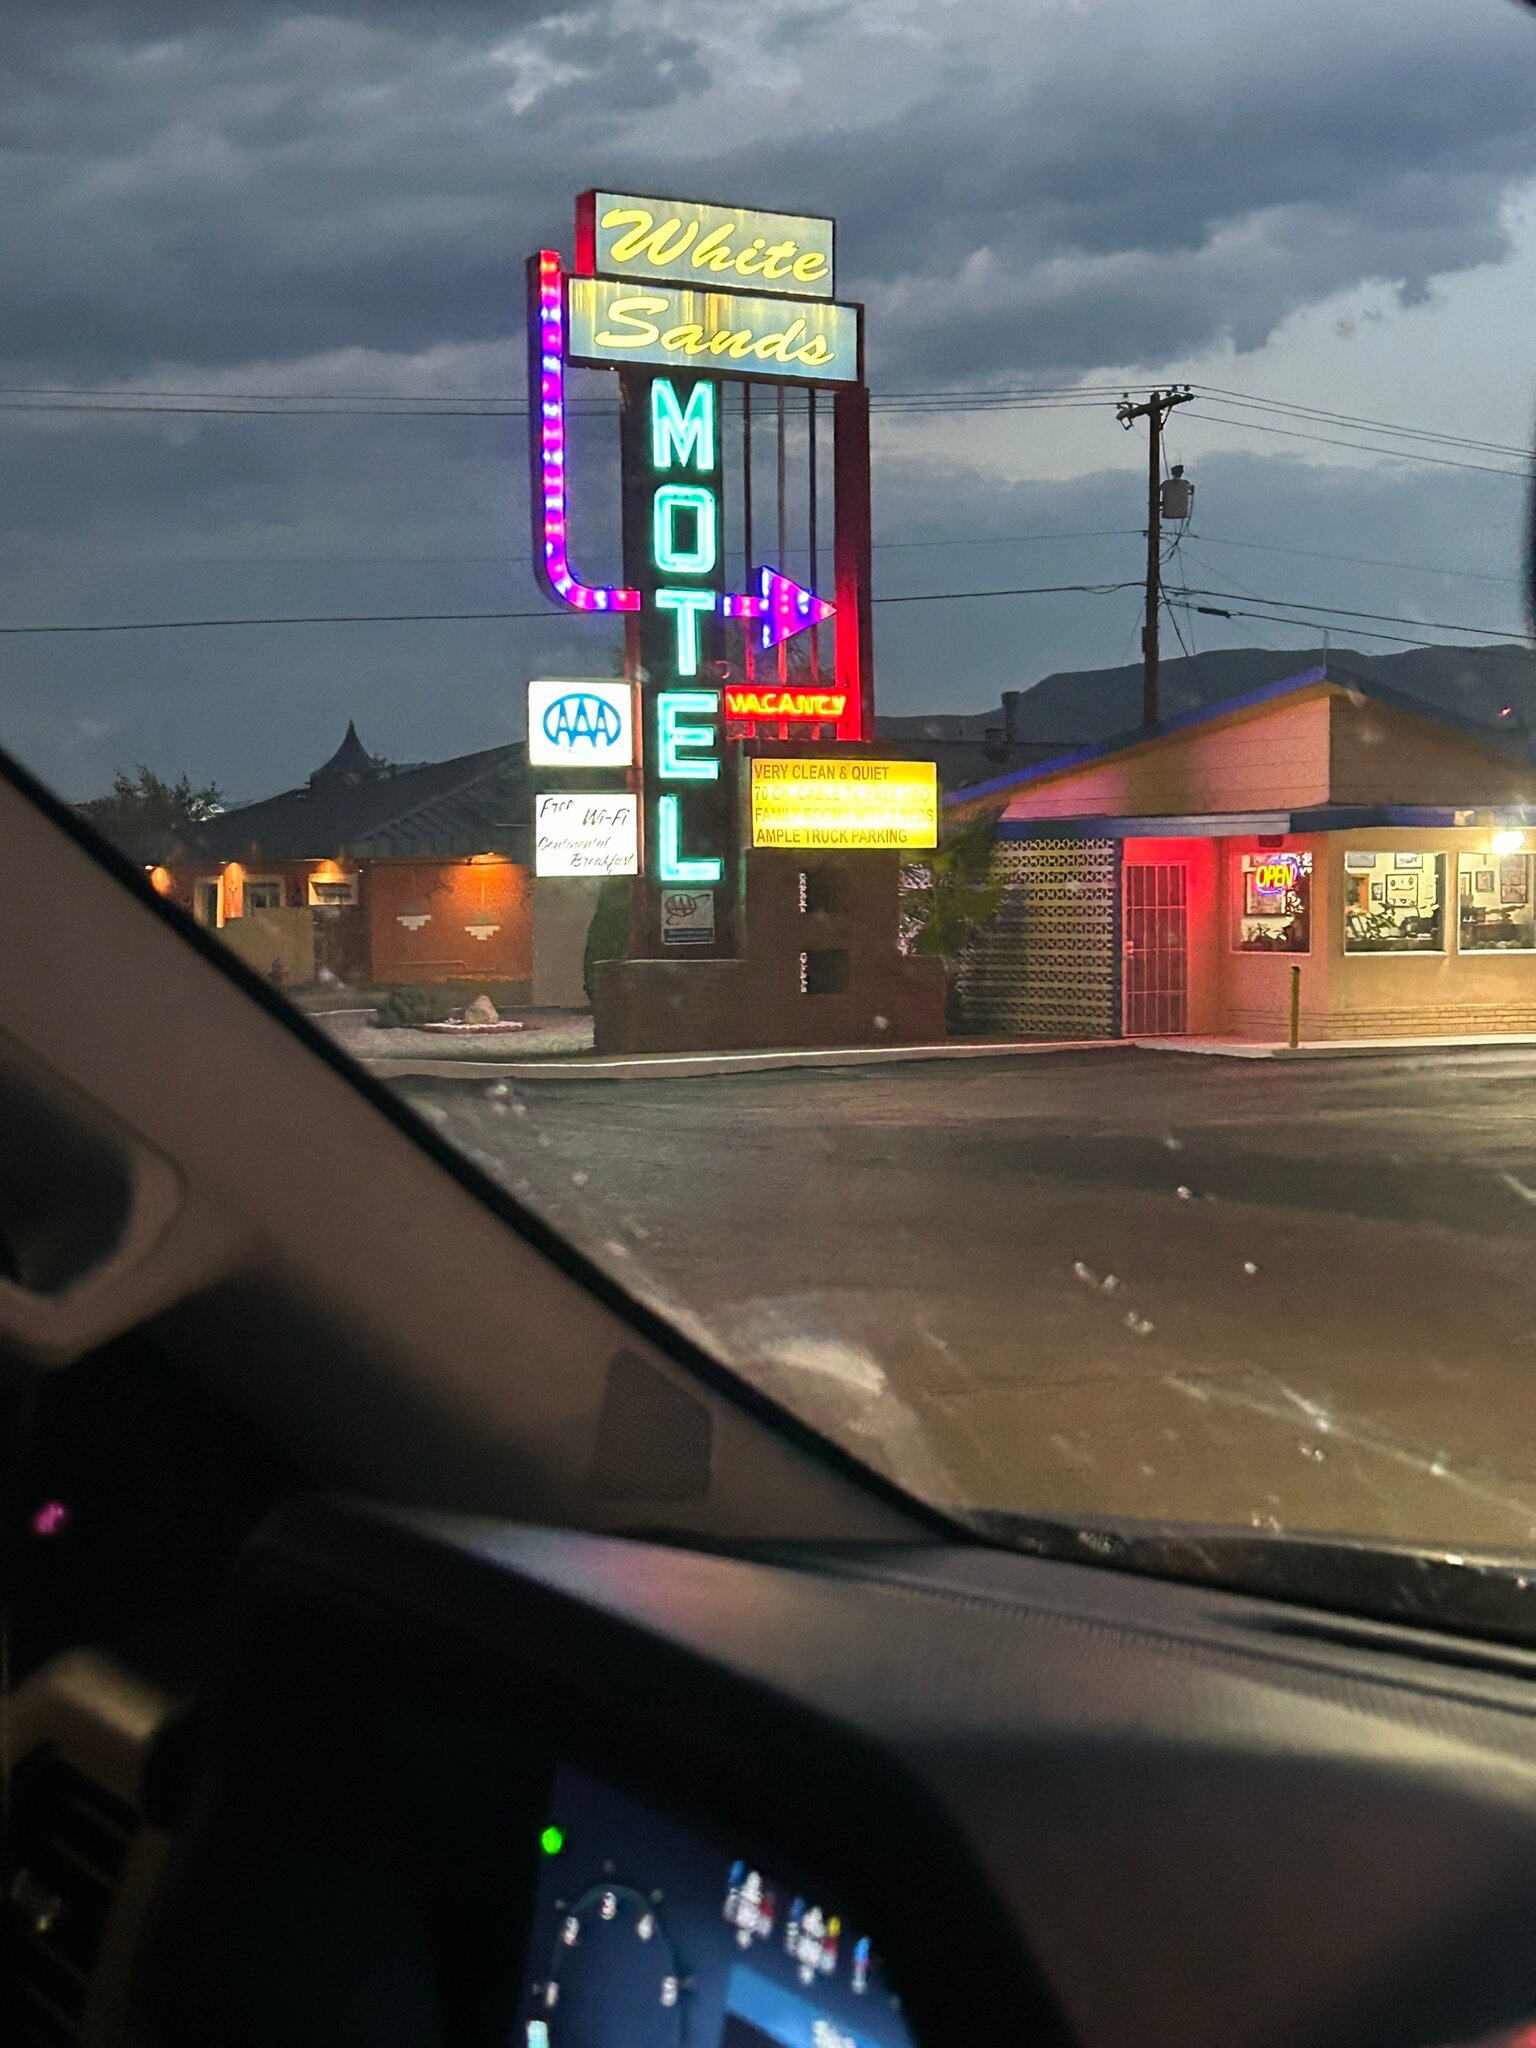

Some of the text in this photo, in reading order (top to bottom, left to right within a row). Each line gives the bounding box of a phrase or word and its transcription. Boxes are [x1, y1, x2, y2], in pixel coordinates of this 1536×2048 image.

[601, 208, 829, 282] White
[595, 295, 835, 365] Sands
[651, 377, 722, 881] MOTEL
[727, 692, 846, 716] VACANCY
[548, 693, 617, 747] AAA
[754, 764, 890, 780] VERY CLEAN & QUIET
[583, 808, 630, 826] Wi-Fi
[756, 829, 908, 844] AMPLE TRUCK PARKING
[1255, 865, 1294, 888] OPEN
